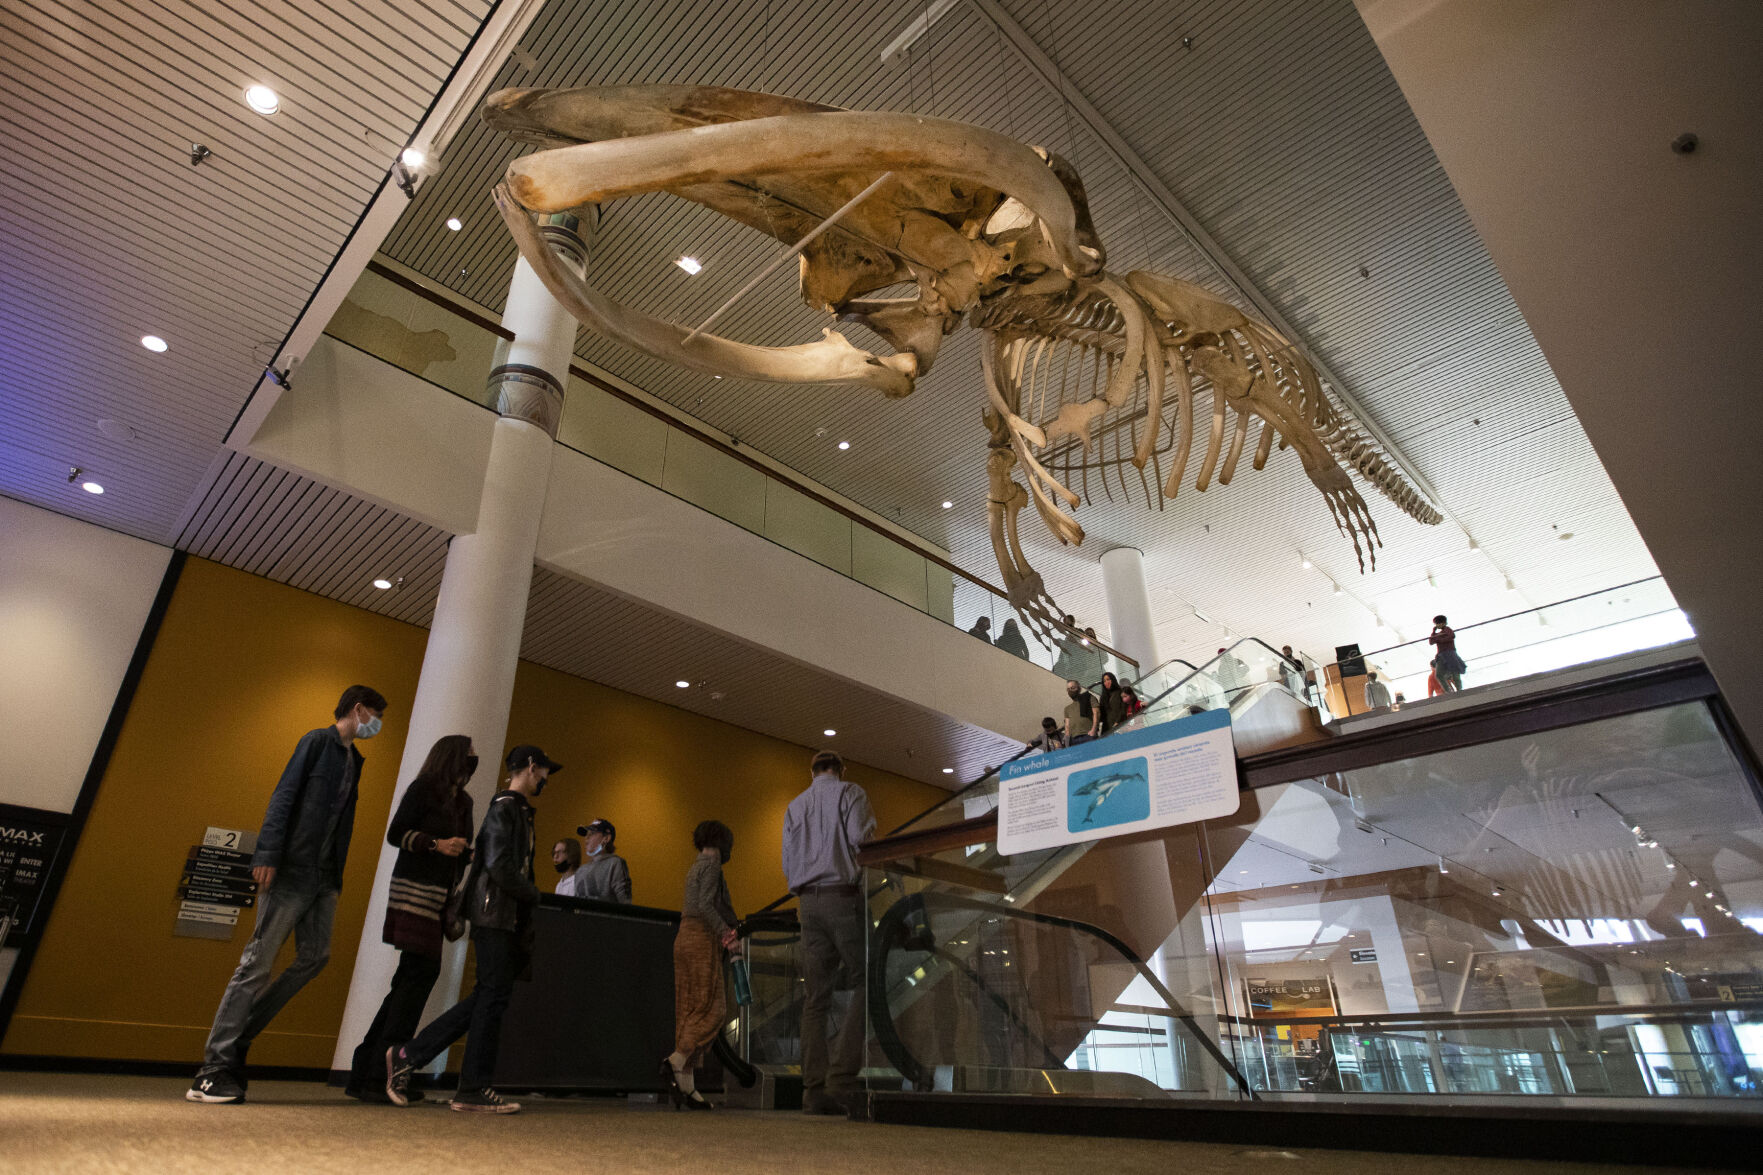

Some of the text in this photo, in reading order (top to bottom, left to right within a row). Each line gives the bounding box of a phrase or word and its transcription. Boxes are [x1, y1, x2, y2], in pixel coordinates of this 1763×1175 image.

[1009, 764, 1021, 775] Fin
[1024, 757, 1050, 772] whale
[224, 832, 237, 847] 2
[20, 857, 42, 867] ENTER
[16, 869, 38, 879] IMAX
[1250, 986, 1288, 994] COFFEE
